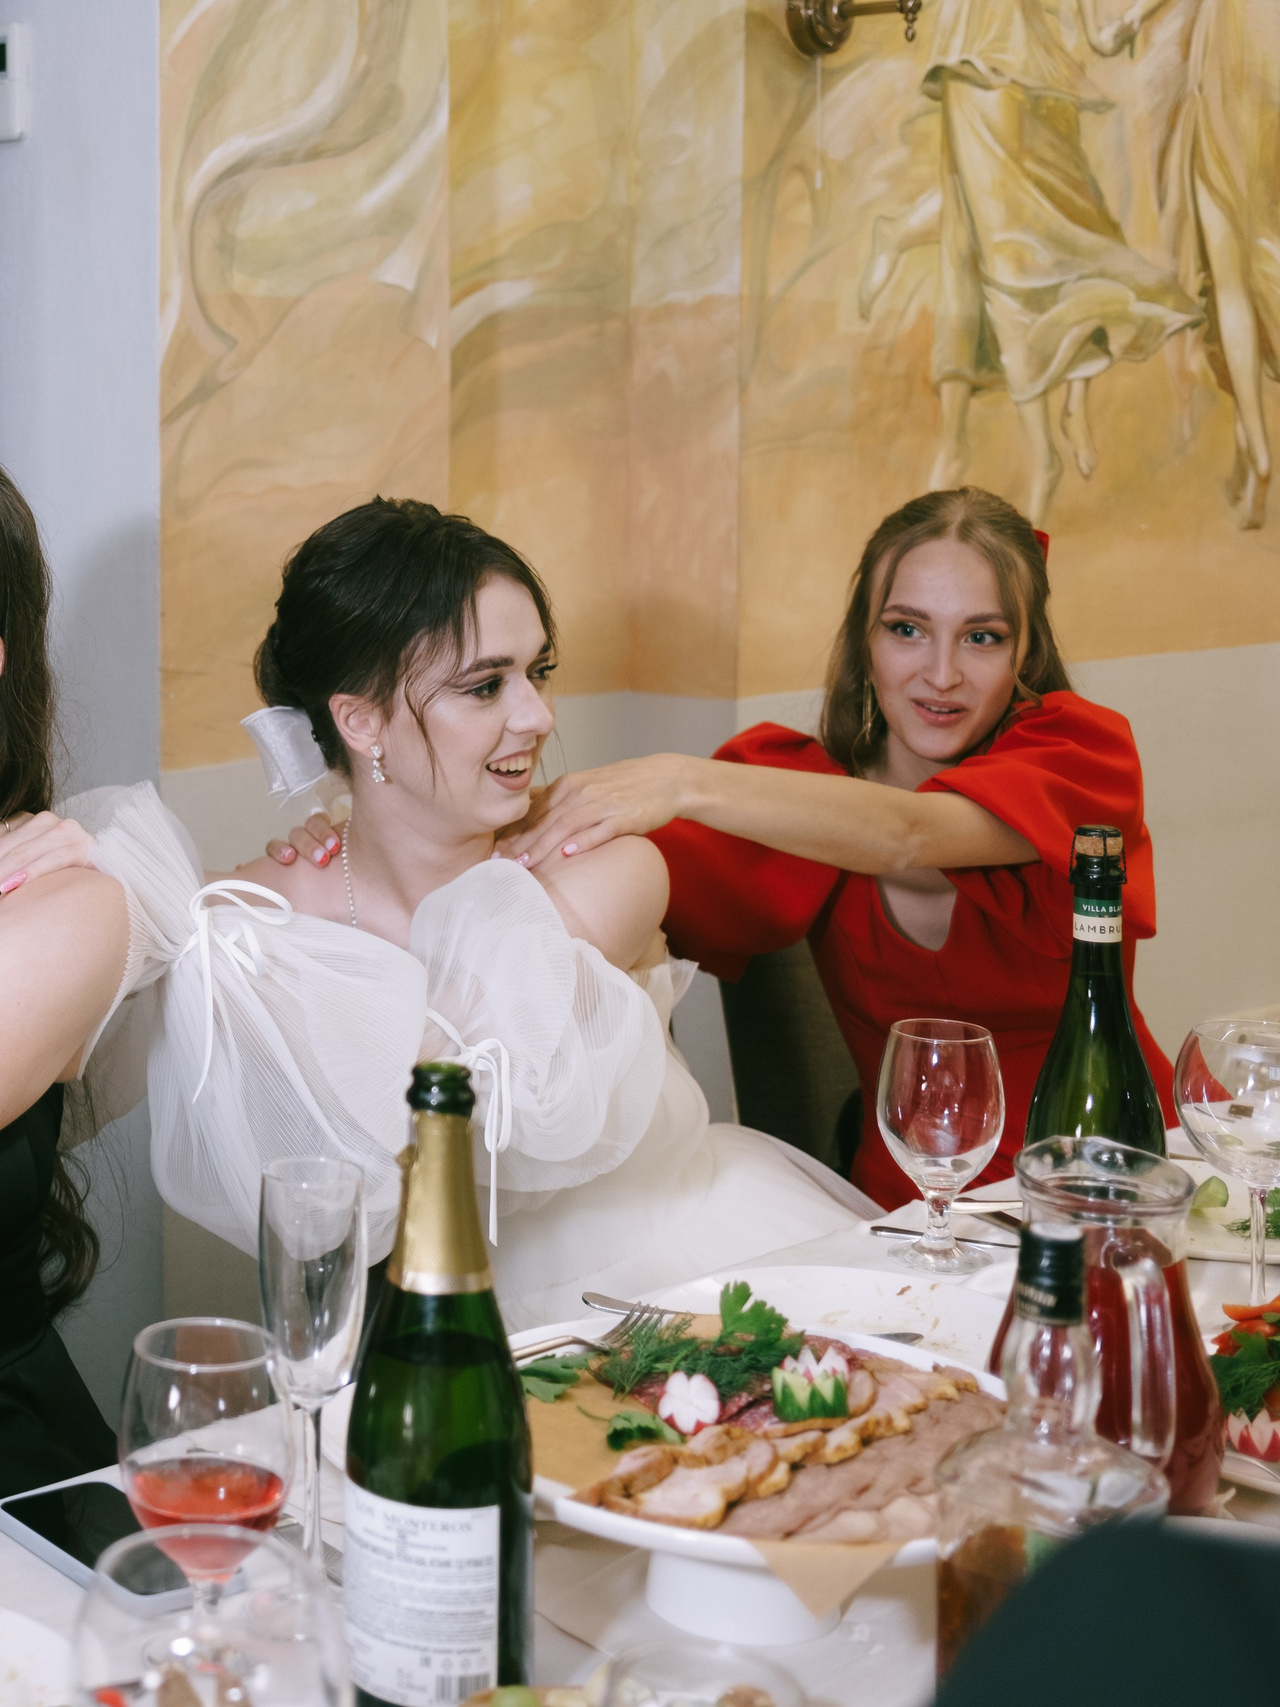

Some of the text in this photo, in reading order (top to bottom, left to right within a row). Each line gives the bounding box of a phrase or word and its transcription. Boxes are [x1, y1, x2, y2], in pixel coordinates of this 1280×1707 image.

[1082, 904, 1106, 912] VILLA
[1074, 922, 1122, 934] LAMBRU
[383, 1511, 472, 1532] MONTEROS
